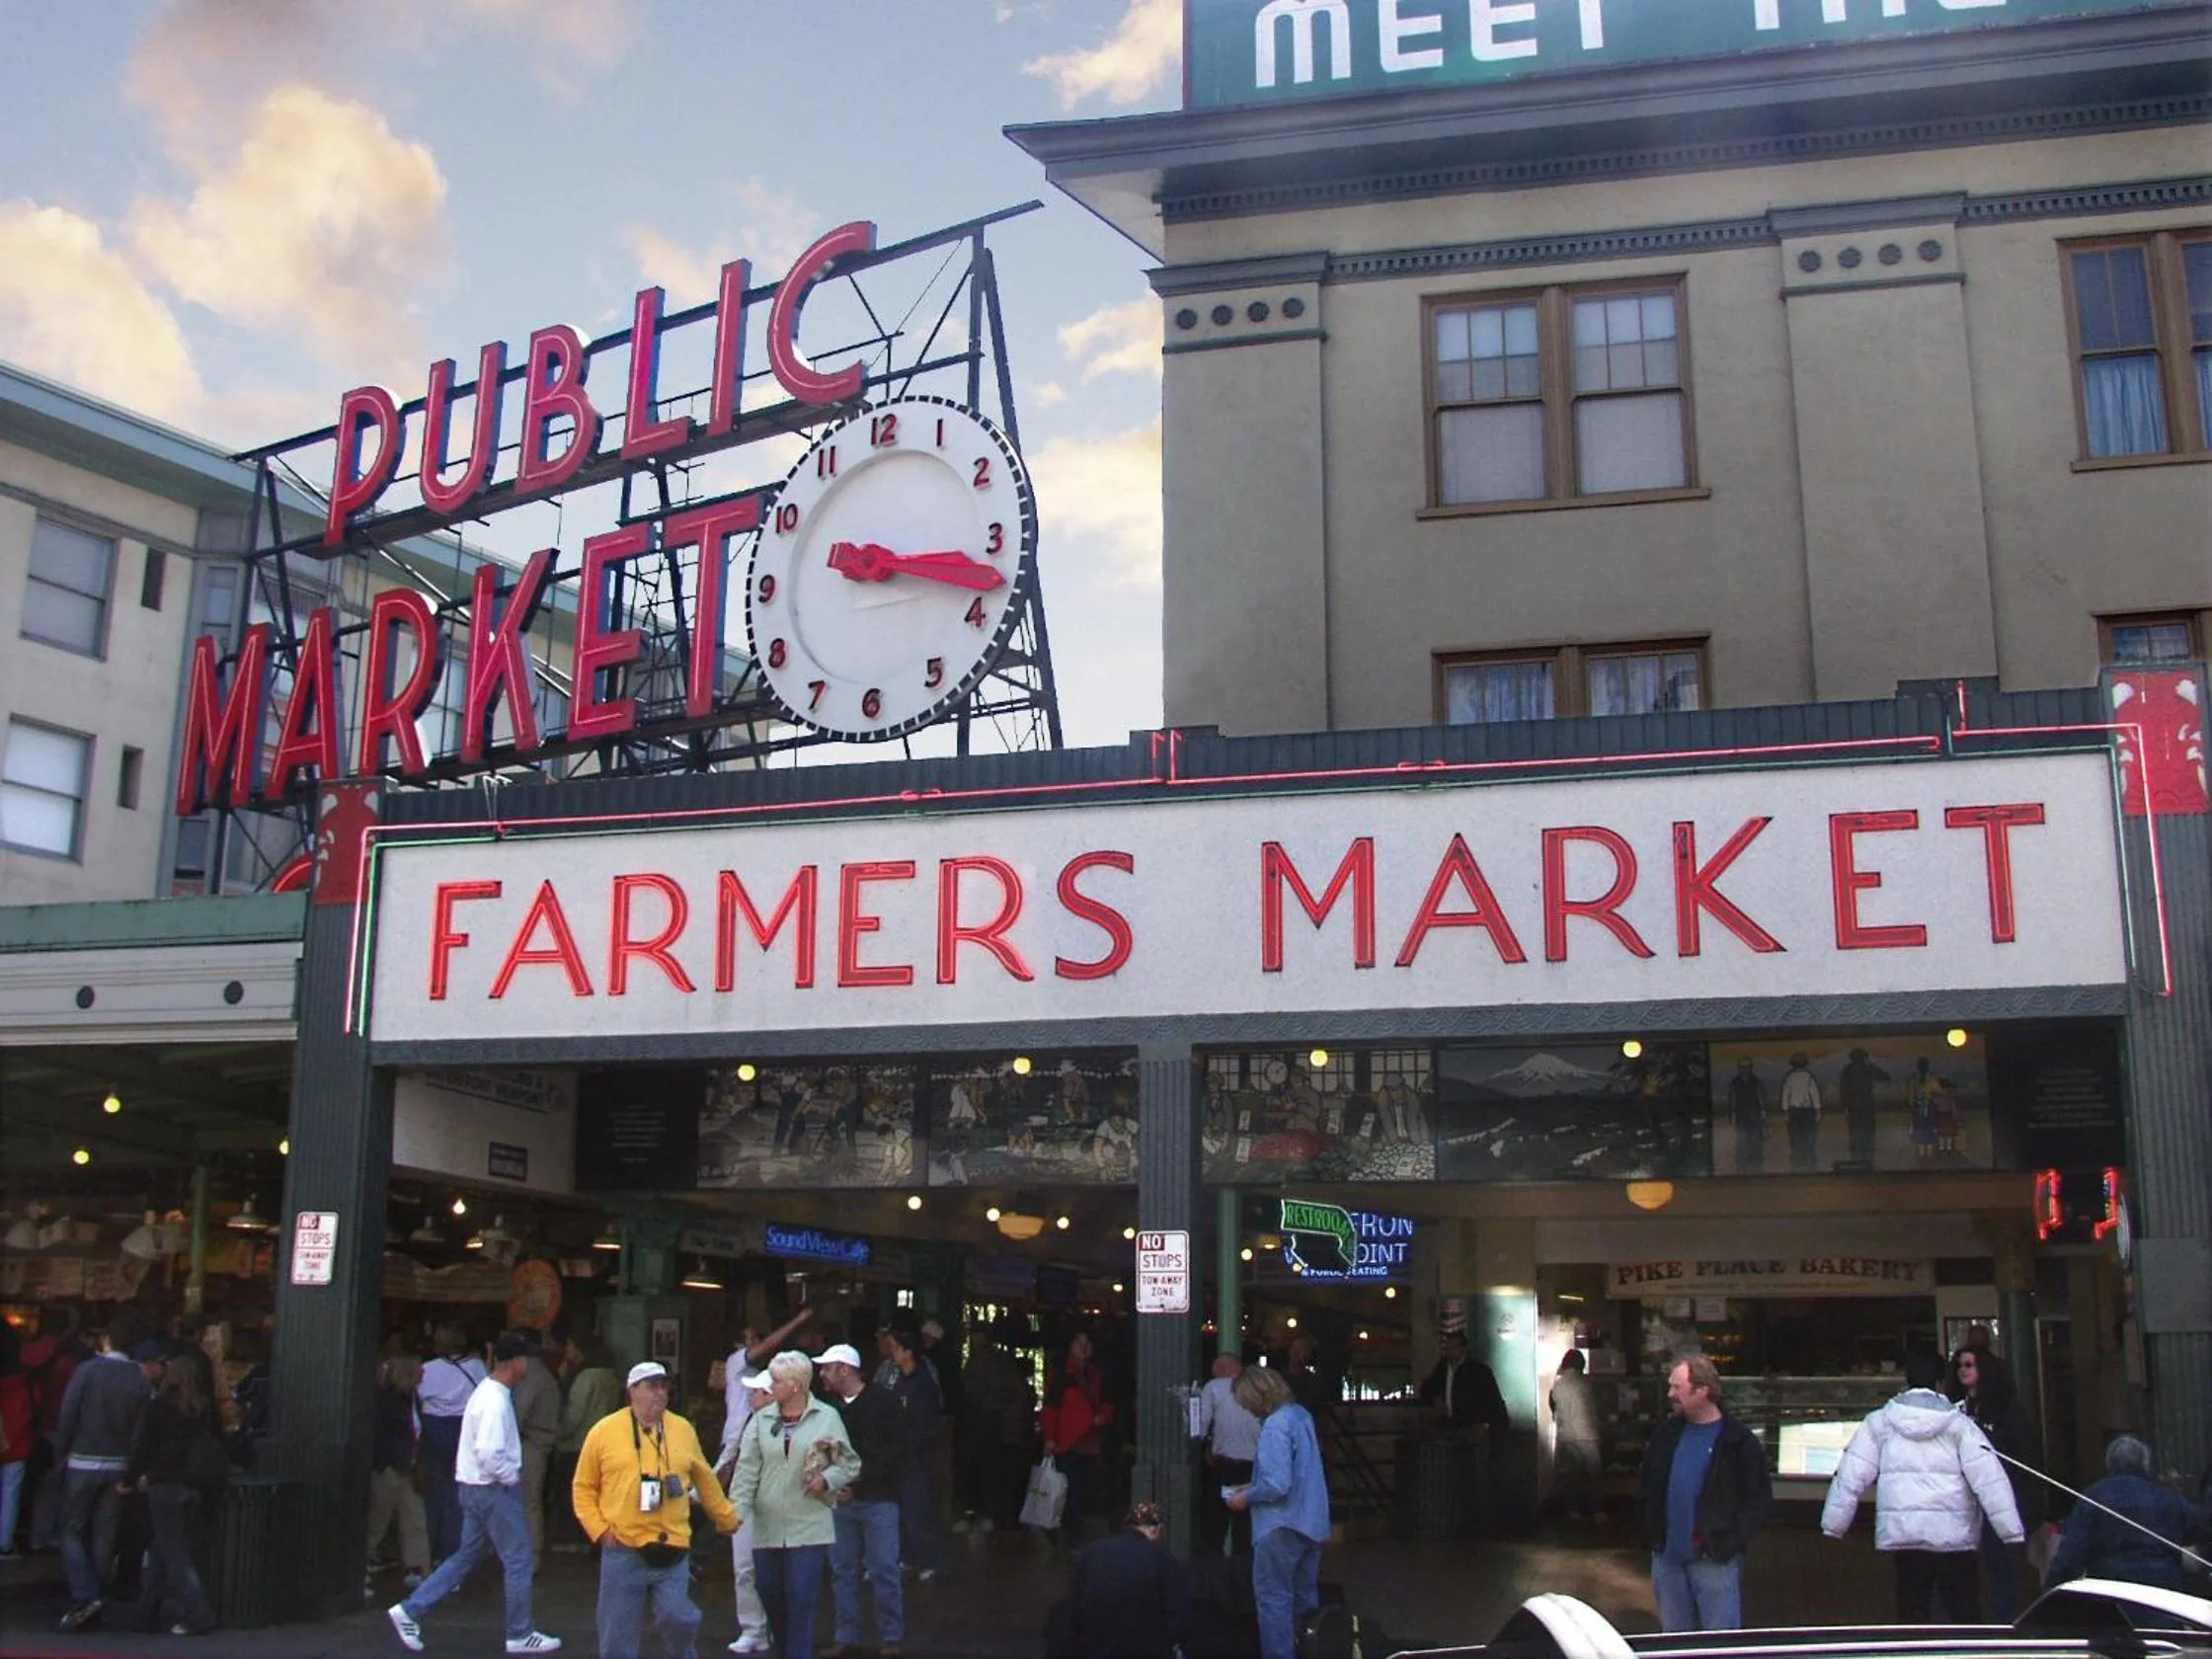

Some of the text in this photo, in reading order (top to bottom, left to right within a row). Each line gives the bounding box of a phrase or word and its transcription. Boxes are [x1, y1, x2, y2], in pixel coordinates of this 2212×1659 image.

[323, 220, 878, 549] PUBLIC
[871, 413, 898, 446] 12
[935, 418, 944, 447] 1
[818, 444, 836, 479] 11
[974, 457, 990, 487] 2
[776, 503, 799, 534] 10
[986, 522, 1004, 554] 3
[758, 574, 775, 603] 9
[964, 596, 986, 627] 4
[176, 492, 765, 816] MARKET
[768, 638, 786, 669] 8
[924, 657, 943, 688] 5
[808, 680, 826, 710] 7
[862, 687, 881, 718] 6
[430, 803, 2045, 1000] FARMERS MARKET
[300, 1215, 318, 1228] NO
[1142, 1233, 1161, 1249] NO
[1143, 1253, 1182, 1268] STOPS
[1618, 1258, 1920, 1285] PIKE PLACE BAKERY
[1151, 1286, 1174, 1297] ZONE
